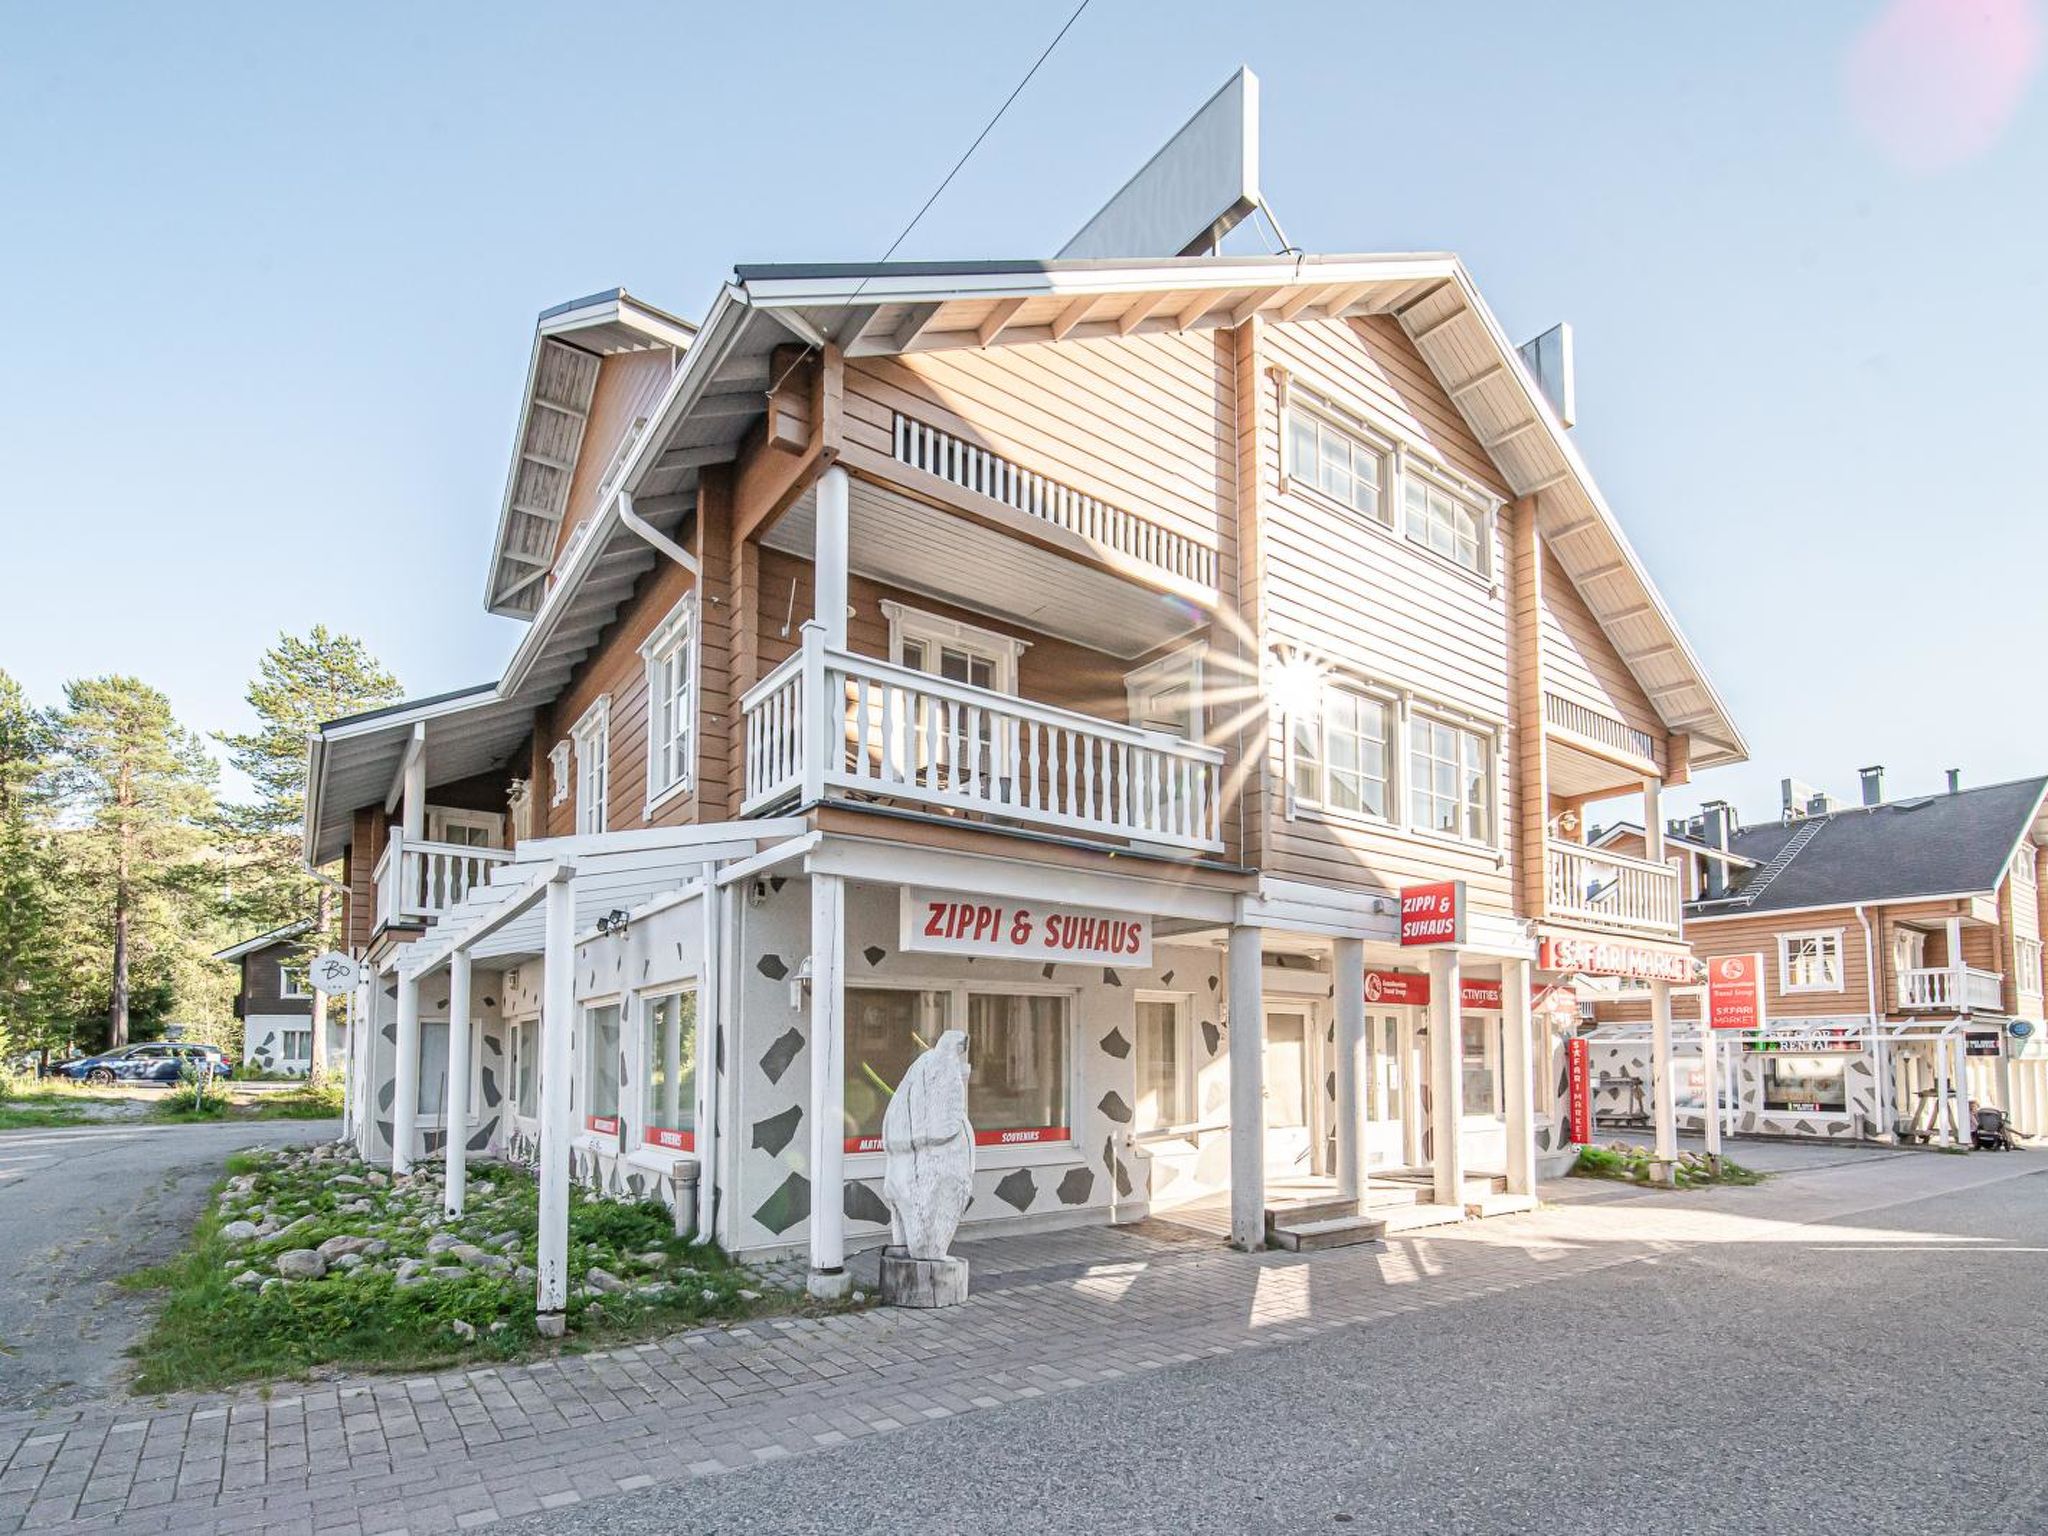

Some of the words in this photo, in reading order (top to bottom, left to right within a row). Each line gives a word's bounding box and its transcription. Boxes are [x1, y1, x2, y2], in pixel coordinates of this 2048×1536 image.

[1402, 895, 1436, 914] ZIPPI
[1439, 896, 1451, 914] &
[924, 903, 1002, 942] ZIPPI
[1010, 909, 1033, 946] &
[1044, 913, 1142, 955] SUHAUS
[1402, 918, 1454, 938] SUHAUS
[1554, 939, 1627, 972] SAFARI
[1629, 946, 1690, 979] MARKET
[1715, 1004, 1754, 1016] SAFARI
[1573, 1040, 1582, 1091] SAFARI
[1573, 1093, 1583, 1142] MARKET
